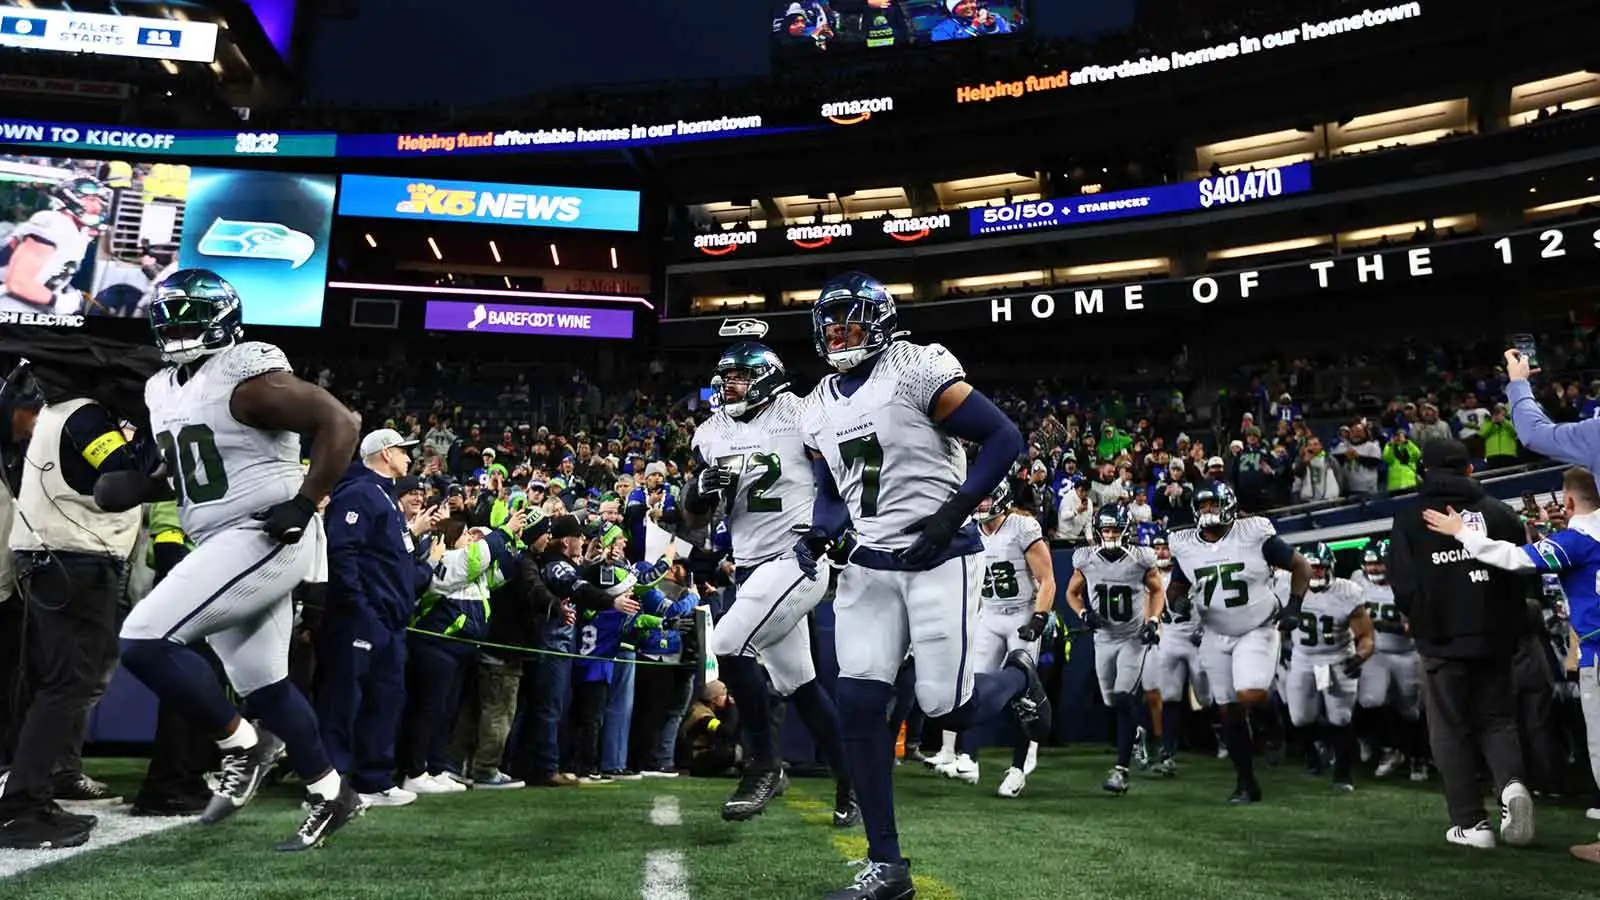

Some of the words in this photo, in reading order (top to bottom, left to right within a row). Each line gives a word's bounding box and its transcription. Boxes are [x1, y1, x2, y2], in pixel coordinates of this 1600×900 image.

[60, 32, 125, 46] STARTS
[69, 20, 121, 34] FALSE
[957, 80, 1024, 102] Helping
[1025, 70, 1068, 91] fund
[1070, 56, 1170, 85] affordable
[1172, 43, 1239, 69] homes
[1240, 36, 1261, 54] in
[1263, 28, 1300, 48] our
[1302, 2, 1420, 40] hometown
[821, 97, 892, 117] amazon
[0, 124, 43, 140] WN
[51, 128, 79, 142] TO
[87, 131, 174, 149] KICKOFF
[397, 133, 456, 152] Helping
[457, 132, 493, 148] fund
[494, 127, 576, 146] affordable
[578, 124, 630, 142] homes
[632, 123, 647, 138] in
[649, 123, 677, 137] our
[678, 114, 762, 135] hometown
[1198, 168, 1282, 208] $40,470
[477, 192, 583, 222] NEWS
[983, 202, 1054, 223] 50/50
[787, 222, 852, 240] amazon
[882, 213, 950, 233] amazon
[694, 230, 758, 248] amazon
[991, 285, 1144, 322] HOME
[1193, 272, 1260, 304] OF
[1311, 248, 1433, 288] THE
[20, 313, 85, 327] ELECTRIC
[488, 311, 553, 328] BAREFOOT
[557, 314, 592, 330] WINE
[836, 421, 874, 437] SEAHAWKS
[715, 452, 783, 512] 72
[838, 431, 884, 518] 7
[1194, 562, 1249, 609] 75
[1094, 584, 1133, 623] 10
[1300, 611, 1336, 646] 91
